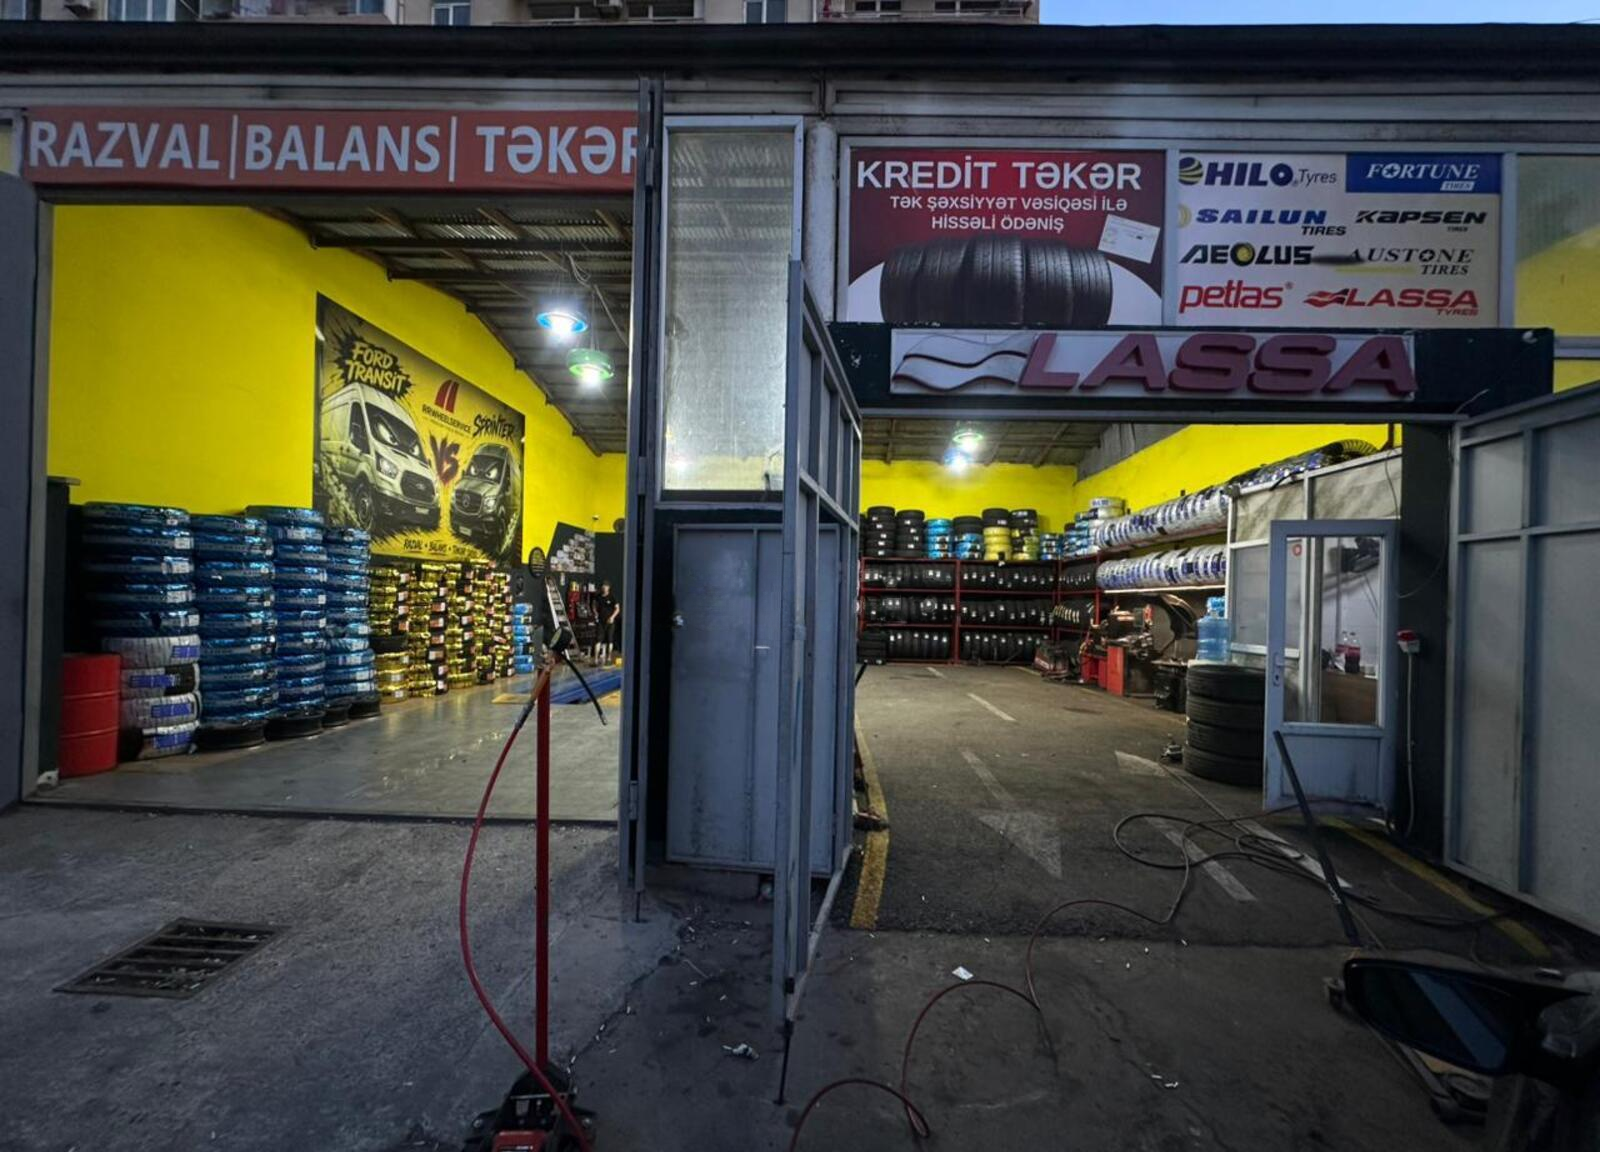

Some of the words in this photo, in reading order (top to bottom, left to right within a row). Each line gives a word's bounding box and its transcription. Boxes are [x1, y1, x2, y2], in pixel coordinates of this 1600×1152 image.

[28, 121, 221, 171] RAZVAL
[244, 126, 441, 174] BALANS
[857, 156, 997, 190] KREDİT
[1012, 161, 1142, 192] TƏKƏR
[1205, 162, 1294, 187] HILO
[1298, 168, 1337, 186] Tyres
[1366, 162, 1480, 180] FORTUNE
[890, 196, 923, 210] TƏK
[926, 195, 1018, 213] ŞƏXSİYYƏT
[1020, 195, 1098, 213] VƏSİQƏSİ
[1101, 196, 1128, 212] İLƏ
[931, 213, 996, 230] HİSSƏLİ
[1000, 213, 1065, 234] ÖDƏNİŞ
[1196, 209, 1327, 225] SAILUN
[1301, 225, 1347, 237] TIRES
[1179, 242, 1315, 266] AEOLUS
[1421, 264, 1469, 276] TIRES
[1179, 280, 1285, 313] petlas
[1344, 288, 1479, 308] LASSA
[1436, 308, 1479, 316] TYRES
[352, 341, 394, 369] FORD
[1018, 332, 1418, 398] LASSA
